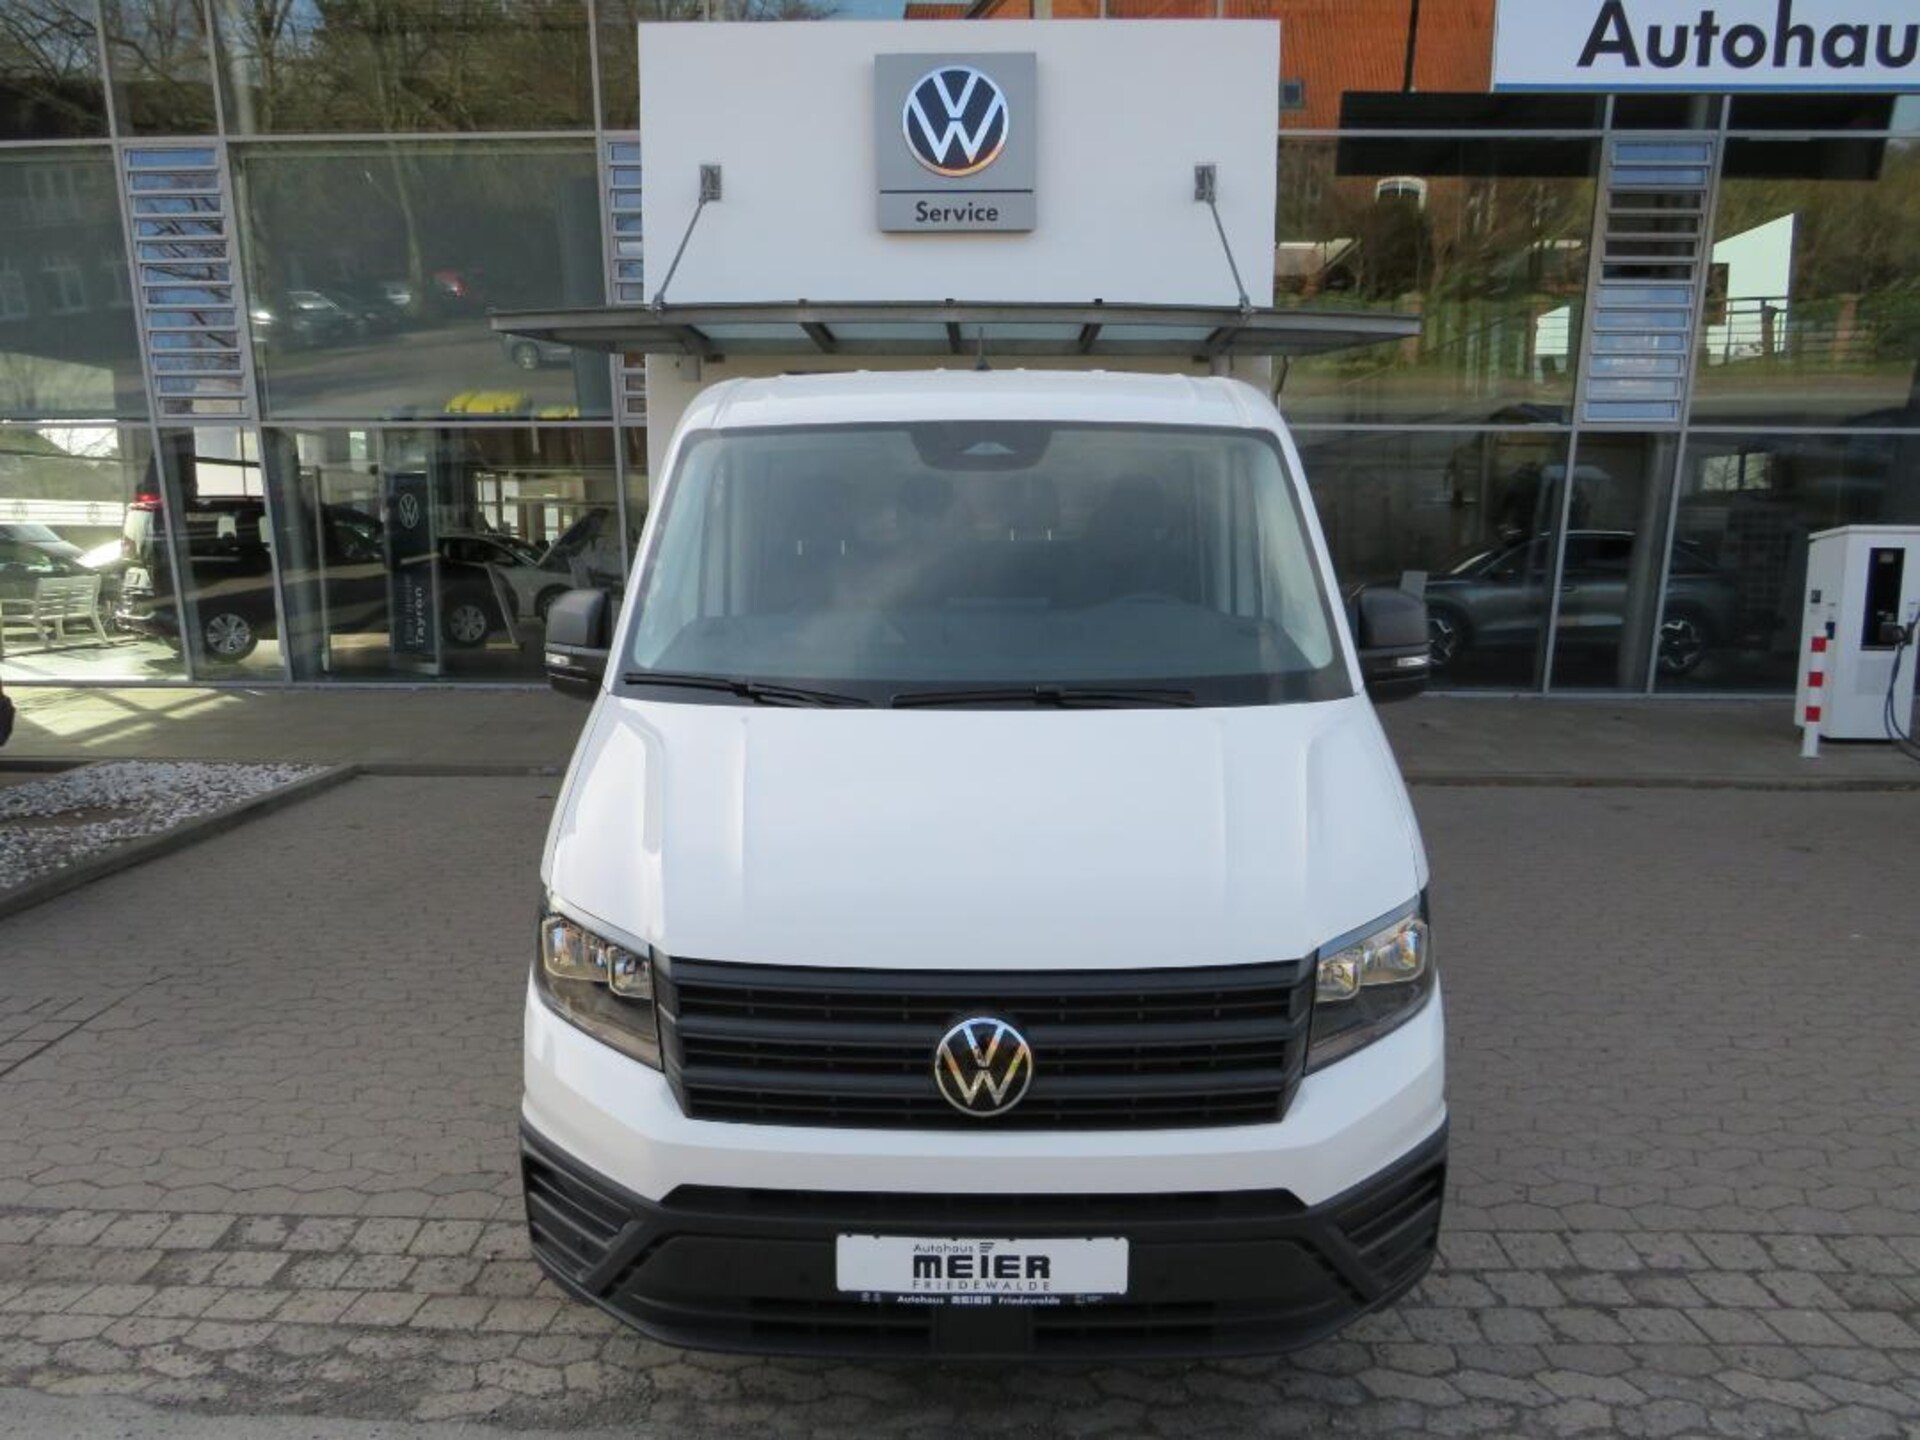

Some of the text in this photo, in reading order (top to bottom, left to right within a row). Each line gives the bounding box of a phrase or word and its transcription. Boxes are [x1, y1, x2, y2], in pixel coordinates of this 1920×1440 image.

[1576, 0, 1920, 69] Autohau
[916, 201, 998, 222] Service
[913, 1243, 973, 1254] Autohaus
[913, 1254, 1050, 1279] MEIER
[913, 1280, 1050, 1292] FRIEDEWALDE
